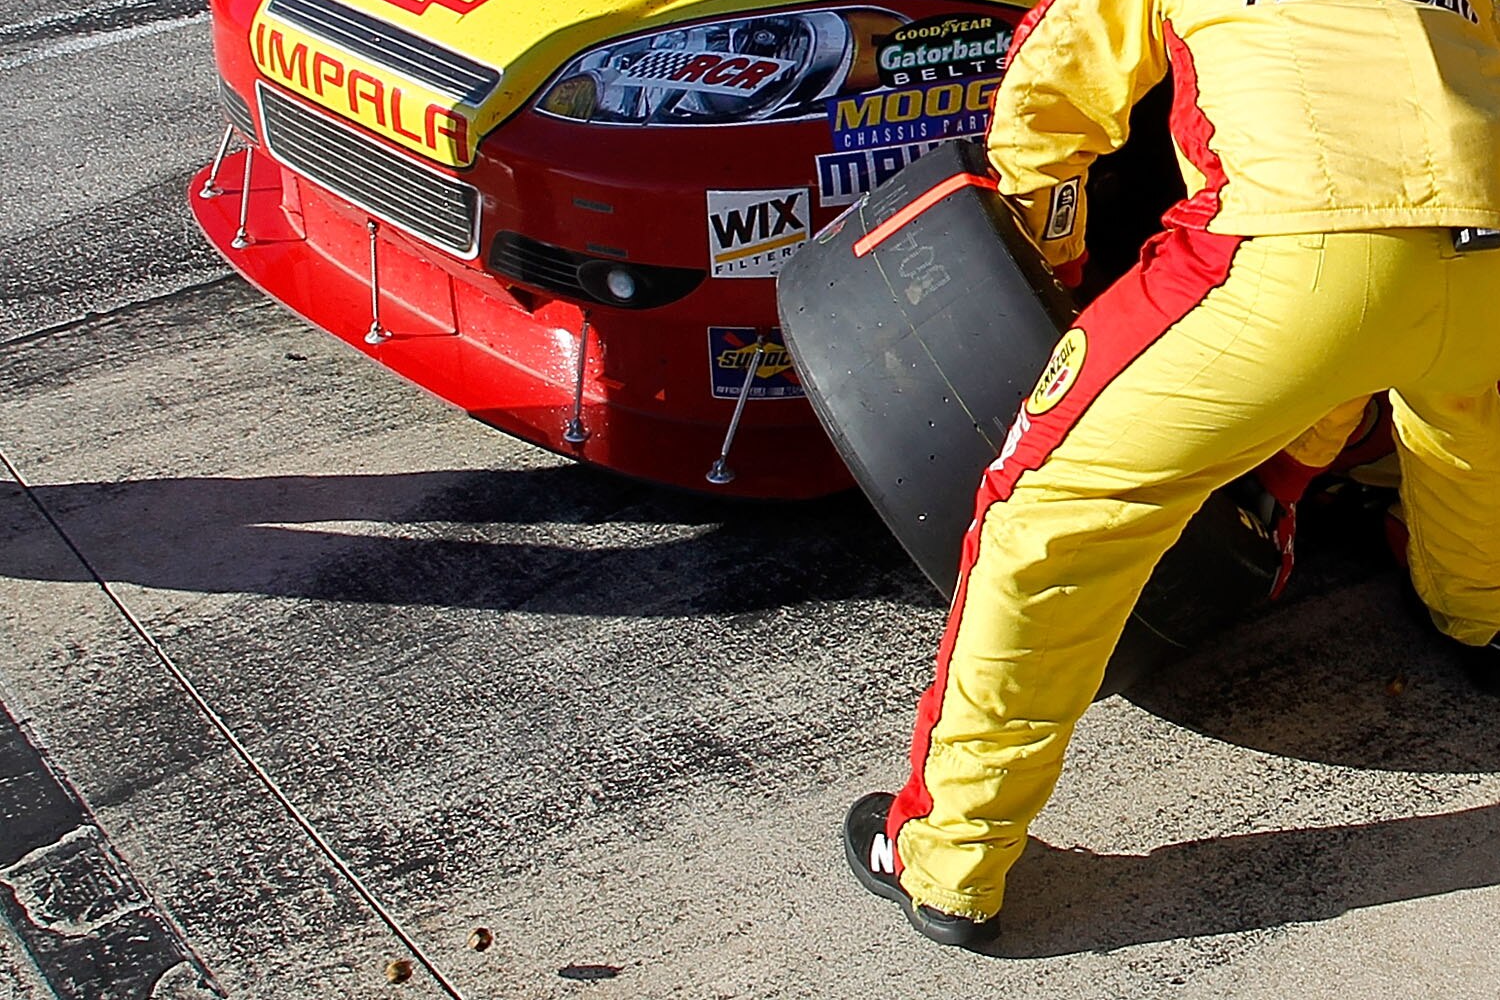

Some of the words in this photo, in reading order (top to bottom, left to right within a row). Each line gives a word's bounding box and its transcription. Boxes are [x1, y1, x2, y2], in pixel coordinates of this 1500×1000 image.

[880, 32, 1012, 71] Gatorback
[676, 55, 779, 89] RCR
[892, 57, 1008, 86] BELTS
[256, 23, 470, 164] IMPALA
[834, 80, 993, 133] MOOG
[843, 123, 928, 147] CHASSIS
[943, 116, 990, 133] PART
[709, 192, 802, 250] WIX
[714, 242, 806, 275] FILTERS
[1034, 339, 1075, 404] PENNZOIL
